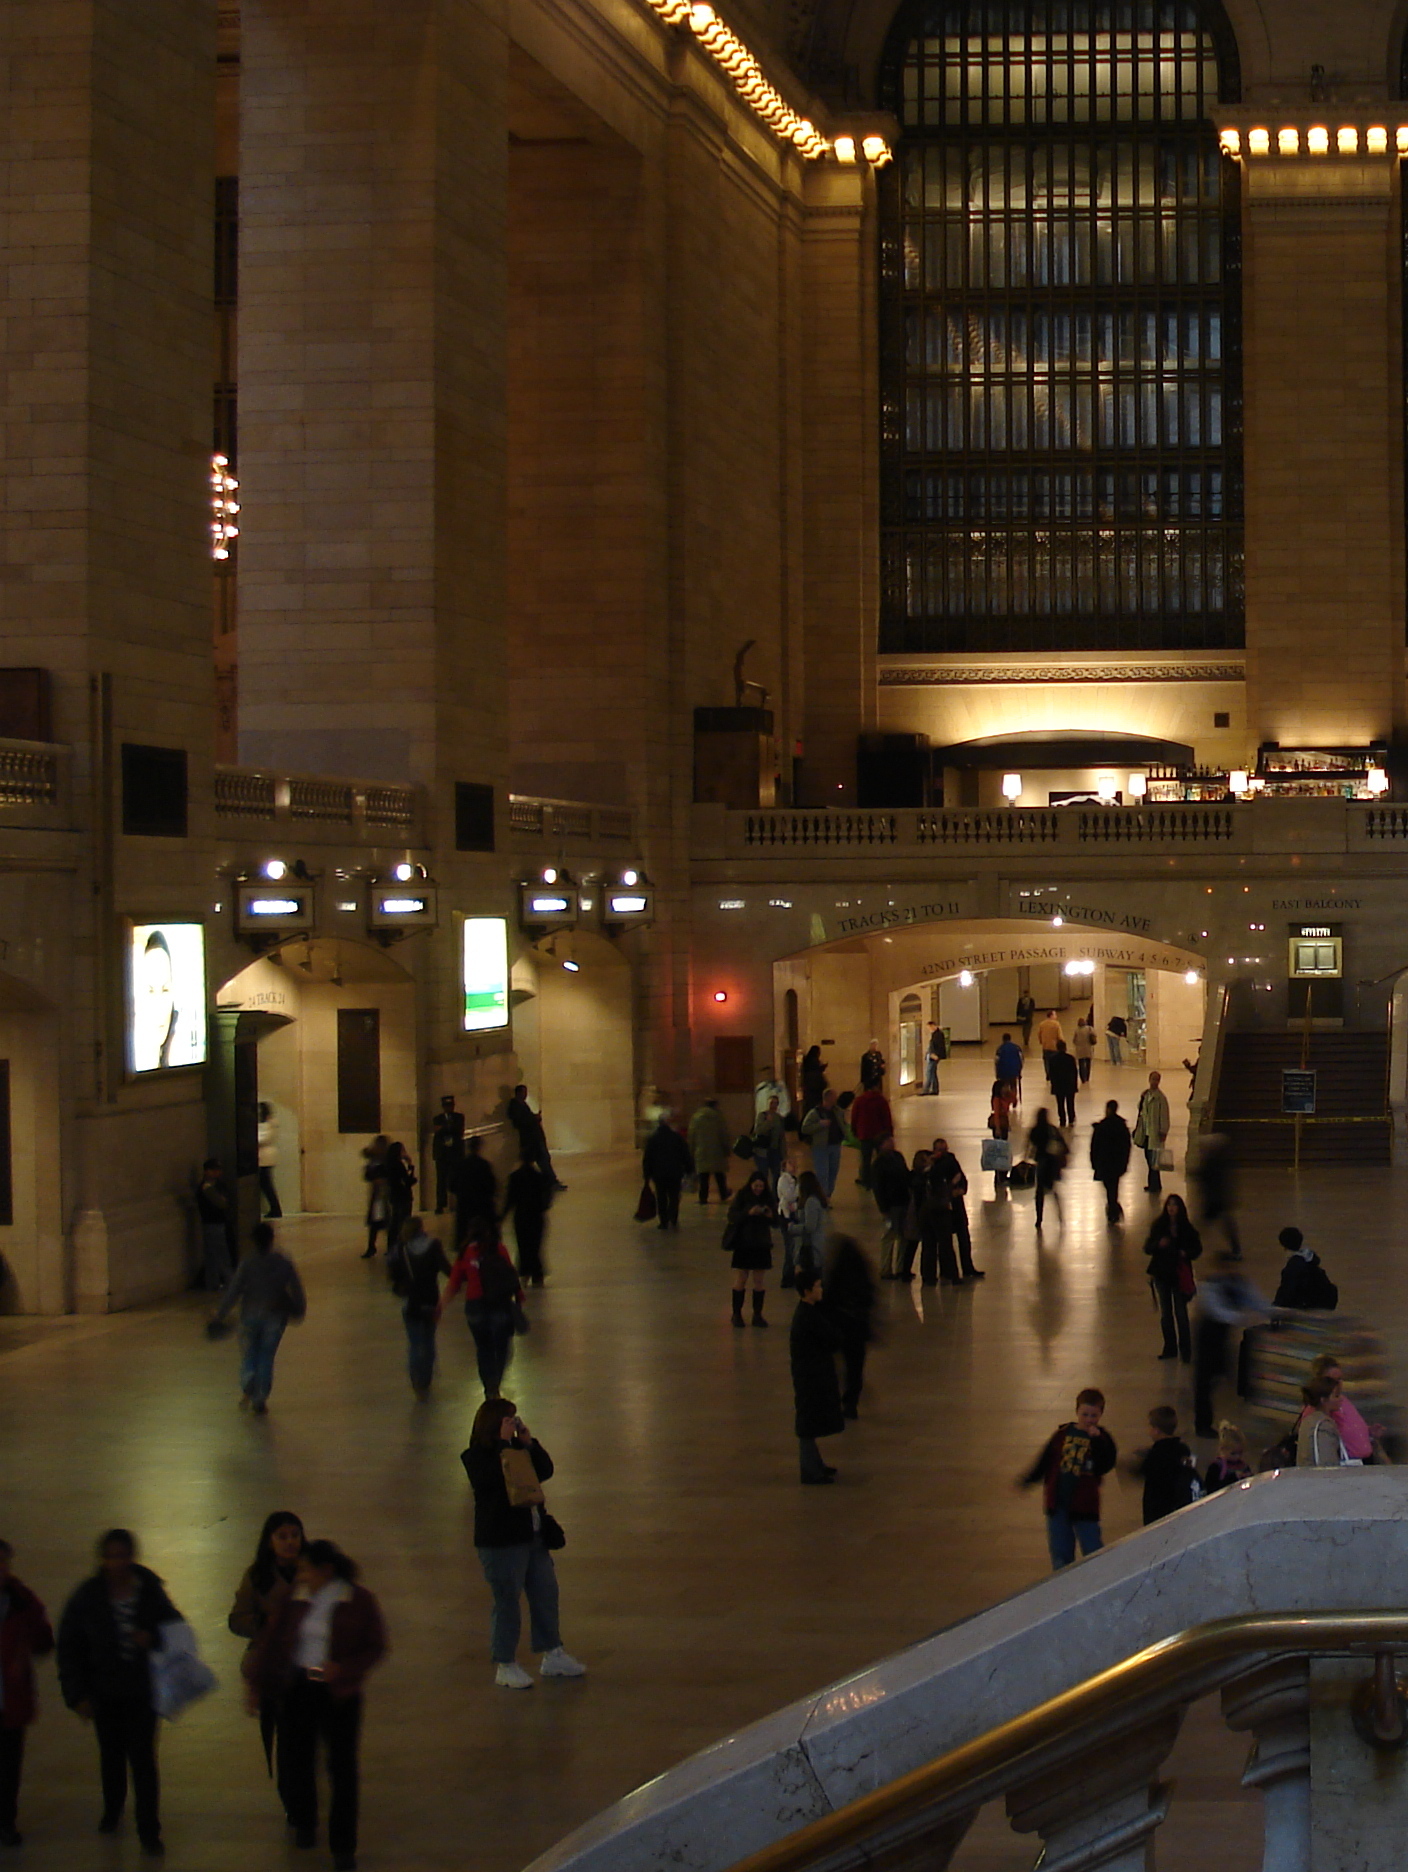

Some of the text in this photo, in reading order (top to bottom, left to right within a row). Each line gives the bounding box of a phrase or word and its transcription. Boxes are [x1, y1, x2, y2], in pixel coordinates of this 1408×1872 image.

[838, 902, 960, 932] TRACKS 21 TO 11
[1019, 901, 1151, 932] LEXINGTON AVE
[1272, 899, 1362, 910] EAST BALCONY
[922, 959, 955, 975] 42ND
[958, 951, 1006, 967] STREET
[1010, 947, 1067, 960] PASSAGE
[1080, 947, 1135, 961] SUBWAY
